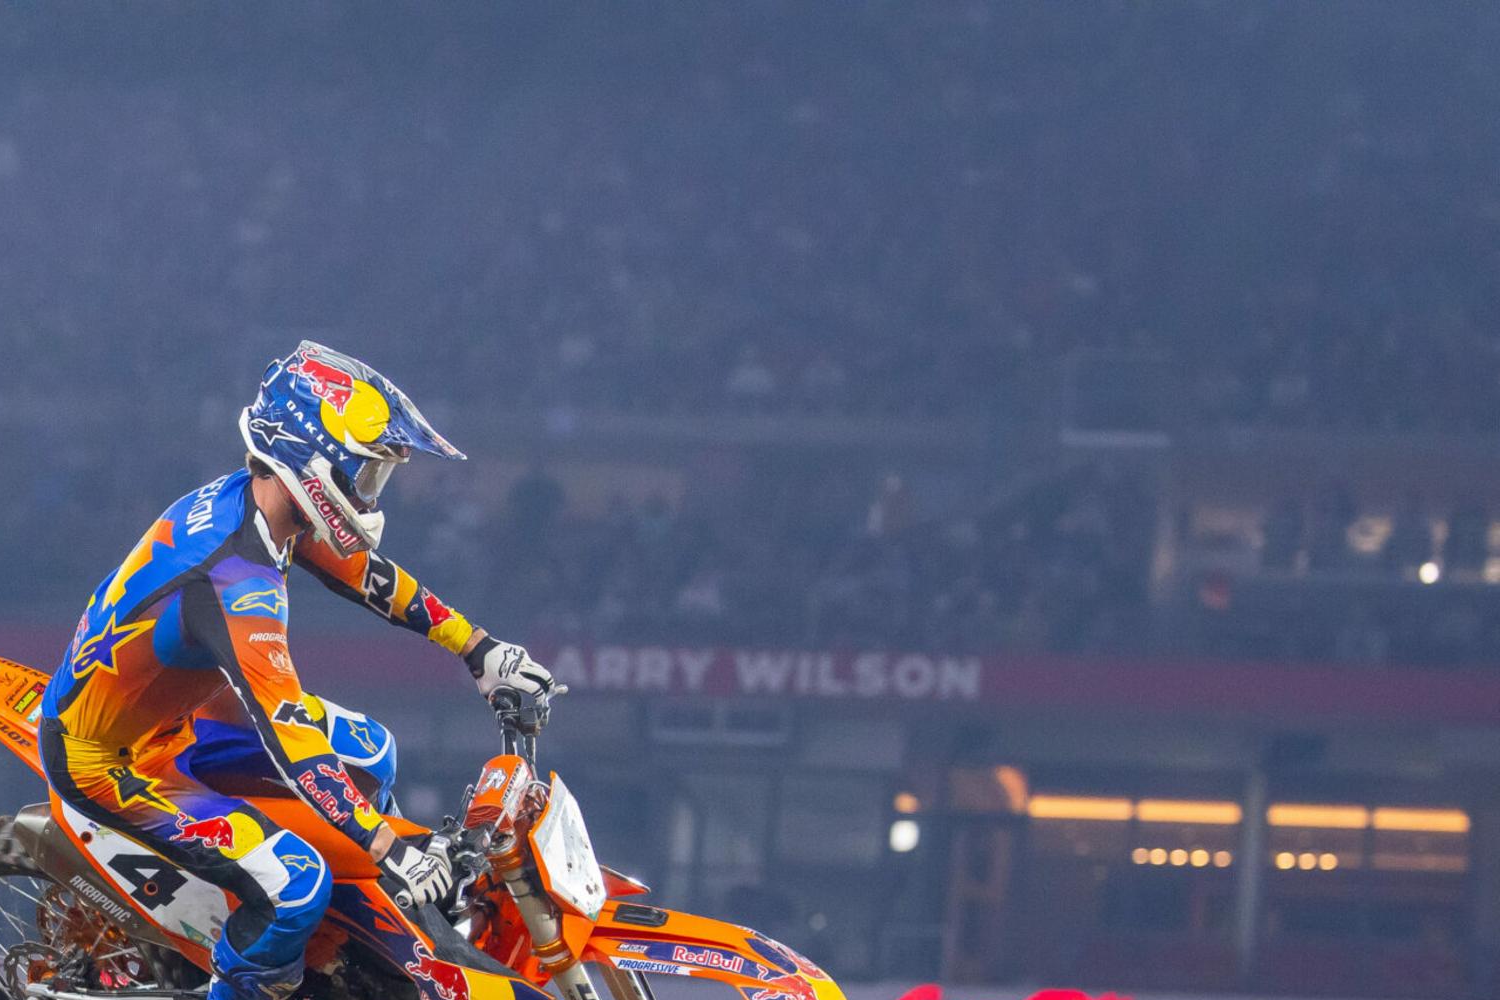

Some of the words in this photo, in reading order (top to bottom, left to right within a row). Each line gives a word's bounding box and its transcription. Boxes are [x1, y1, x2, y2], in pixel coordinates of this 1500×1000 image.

[286, 400, 349, 462] OAKLEY
[553, 647, 714, 690] ARRY
[733, 650, 981, 699] WILSON
[107, 854, 189, 911] 4
[617, 959, 681, 974] PROGRESSIVE
